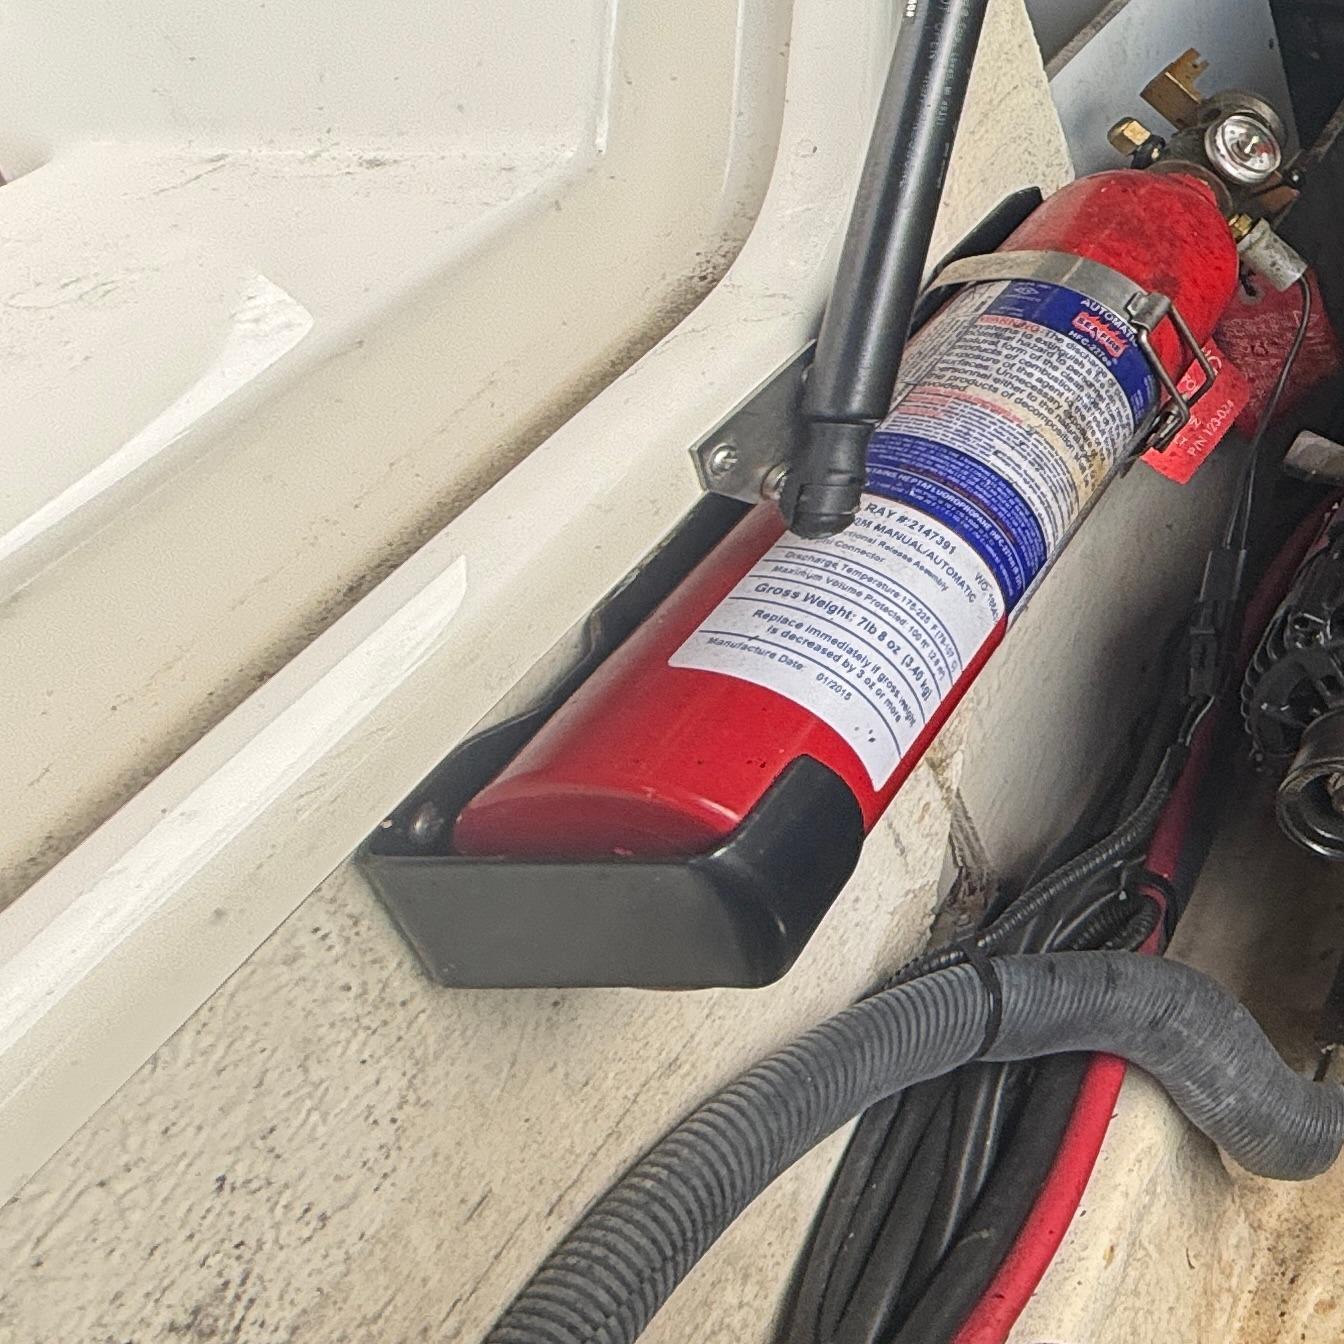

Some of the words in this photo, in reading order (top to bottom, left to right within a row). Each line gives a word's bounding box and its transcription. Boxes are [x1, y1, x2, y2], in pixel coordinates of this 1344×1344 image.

[865, 503, 897, 519] RAY
[873, 523, 976, 604] MANUAL/AUTOMATIC
[754, 583, 800, 601] Gross
[708, 637, 776, 659] Manufacture
[752, 609, 803, 629] Replace
[806, 624, 870, 668] immediately
[766, 625, 777, 635] is
[781, 630, 841, 662] decreased
[841, 660, 856, 677] by
[856, 670, 864, 679] 3
